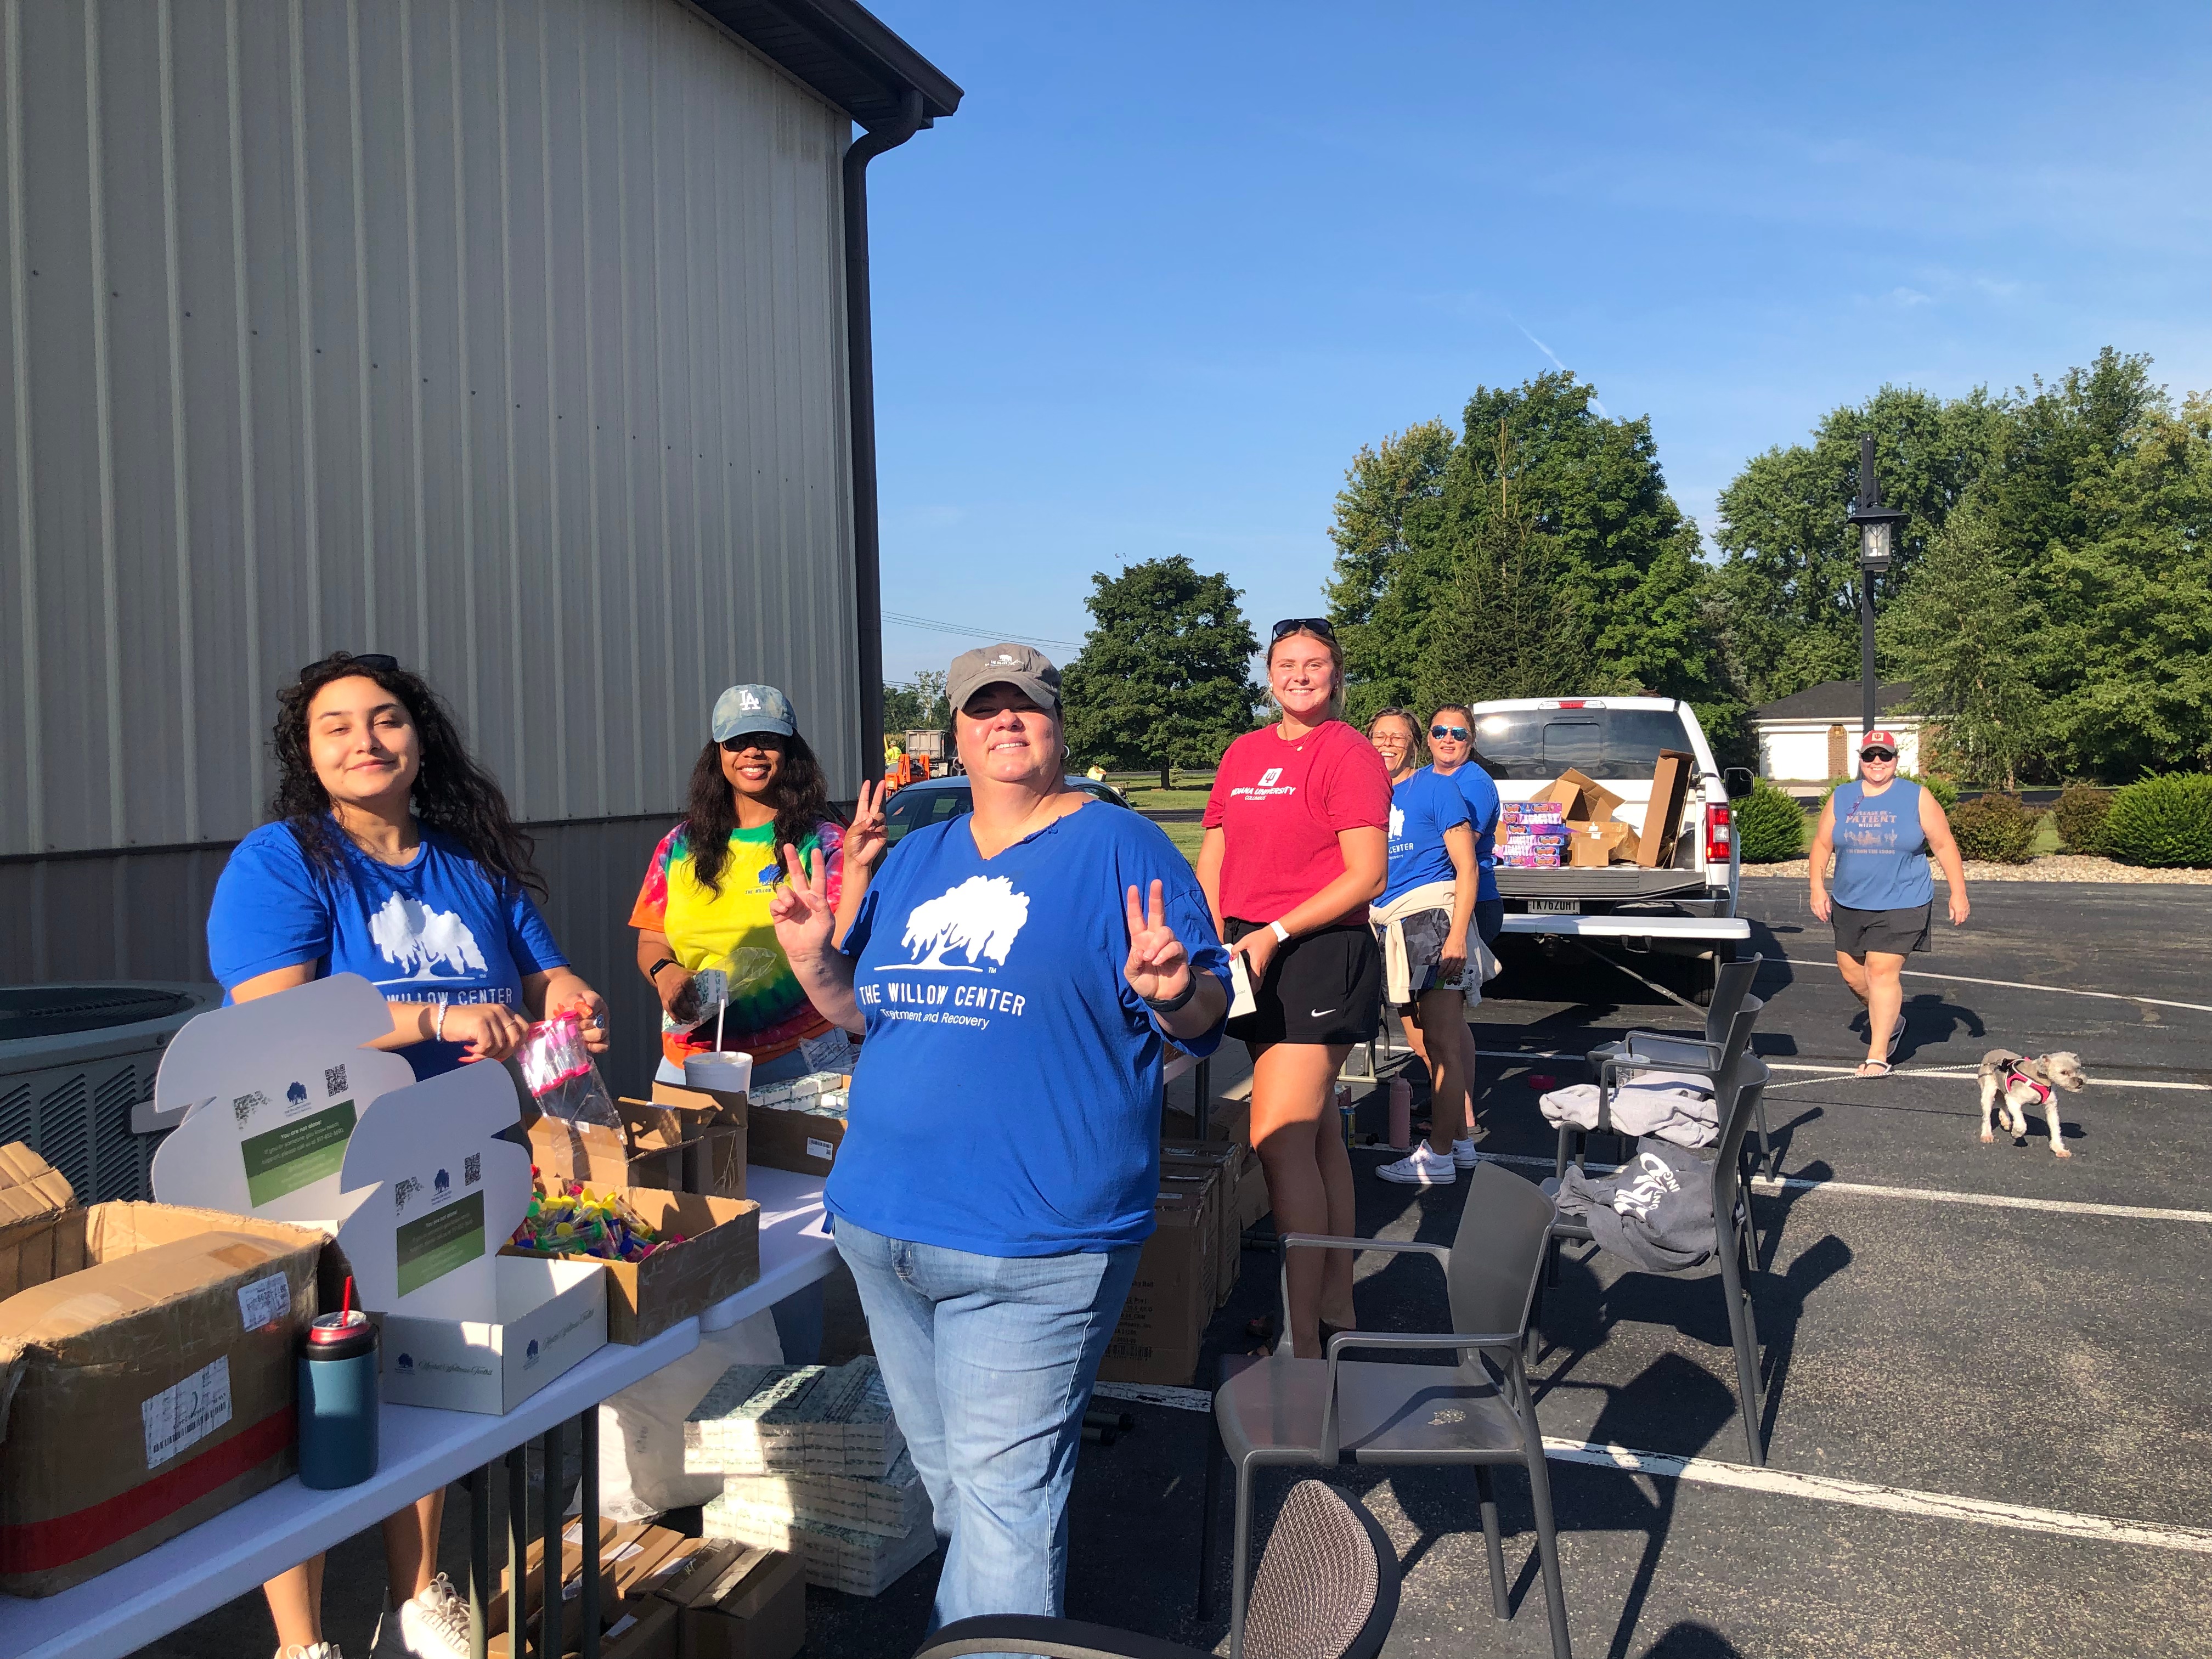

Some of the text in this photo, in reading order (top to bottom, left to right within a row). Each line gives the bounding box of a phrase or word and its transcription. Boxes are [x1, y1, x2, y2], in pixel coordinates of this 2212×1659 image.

[739, 689, 761, 711] LA
[1845, 815, 1897, 823] PATIENT
[1389, 843, 1414, 854] CENTER
[458, 988, 512, 1005] CENTER
[859, 983, 1025, 1016] THE WILLOW CENTER
[923, 1012, 939, 1023] and
[941, 1012, 990, 1030] Recovery
[308, 1119, 322, 1129] alone!
